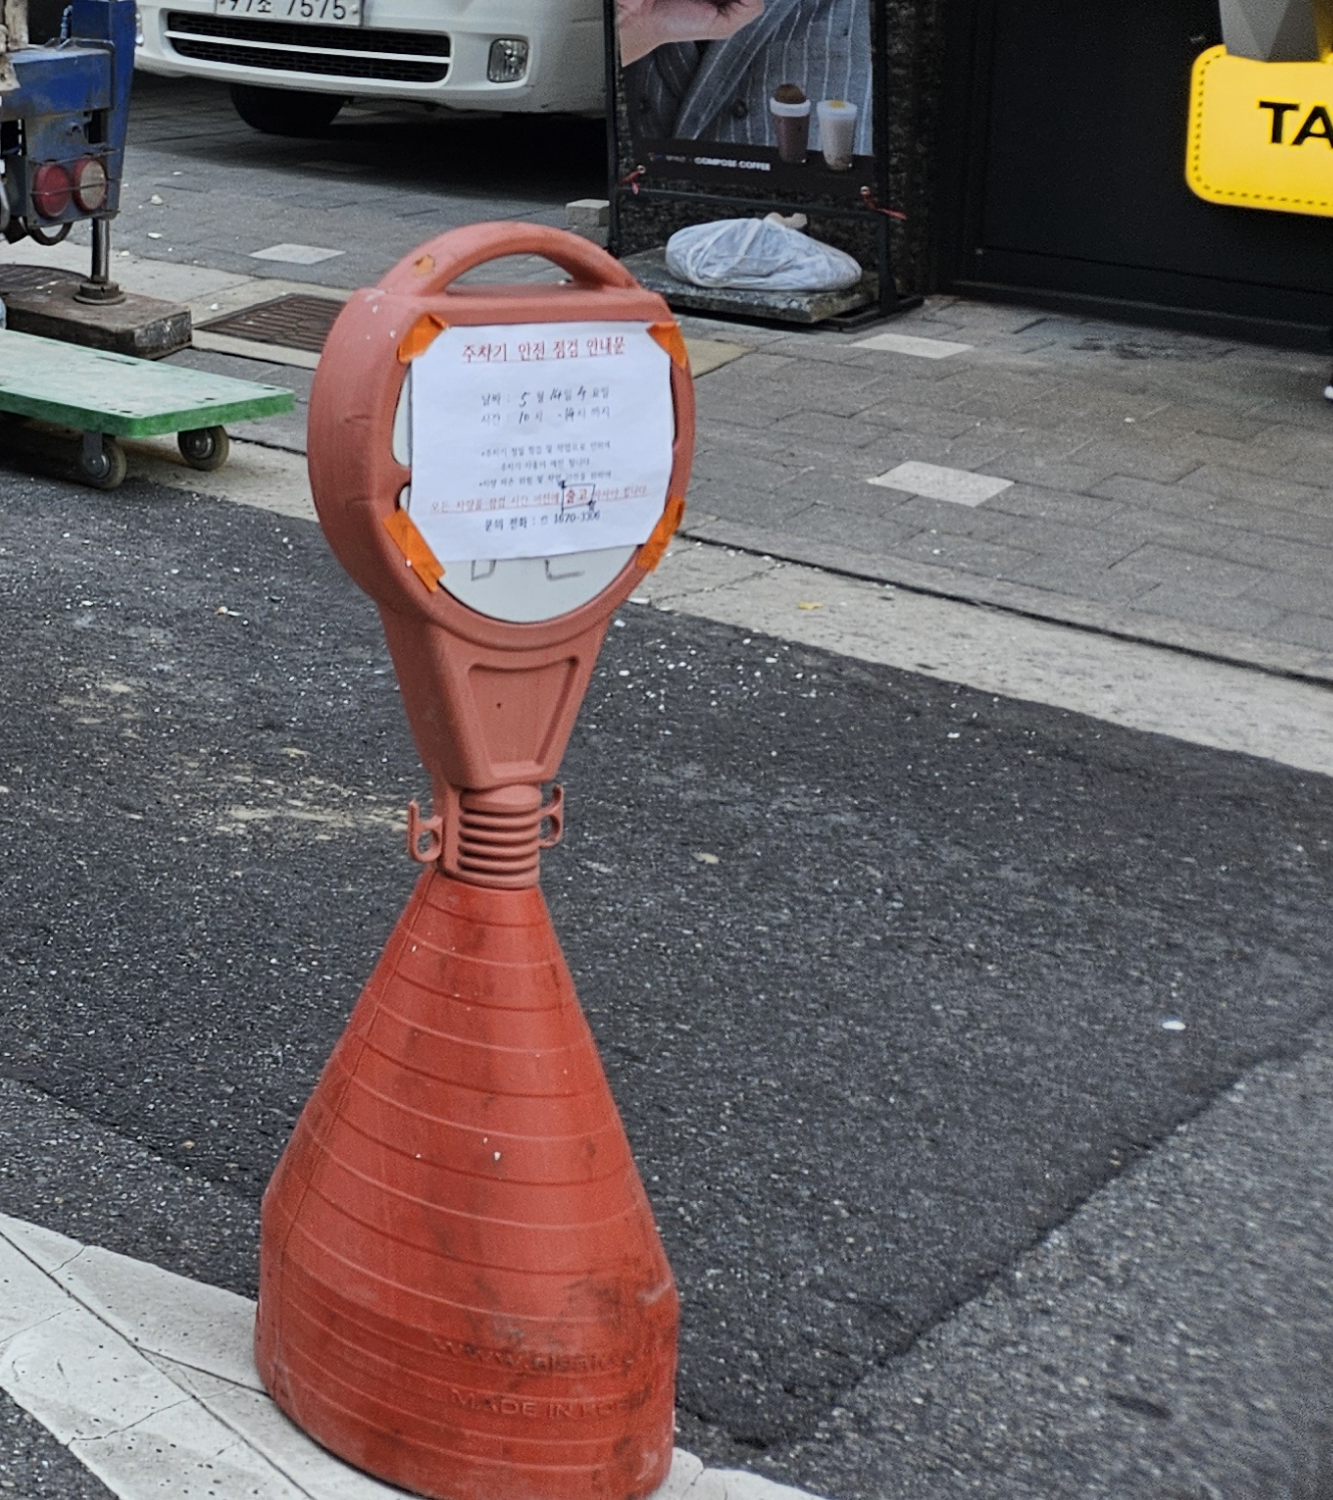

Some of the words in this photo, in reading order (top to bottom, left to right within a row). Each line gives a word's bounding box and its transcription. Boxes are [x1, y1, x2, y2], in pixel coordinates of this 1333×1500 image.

[462, 342, 507, 363] 주차기
[518, 341, 545, 361] 안전
[553, 339, 578, 359] 점검
